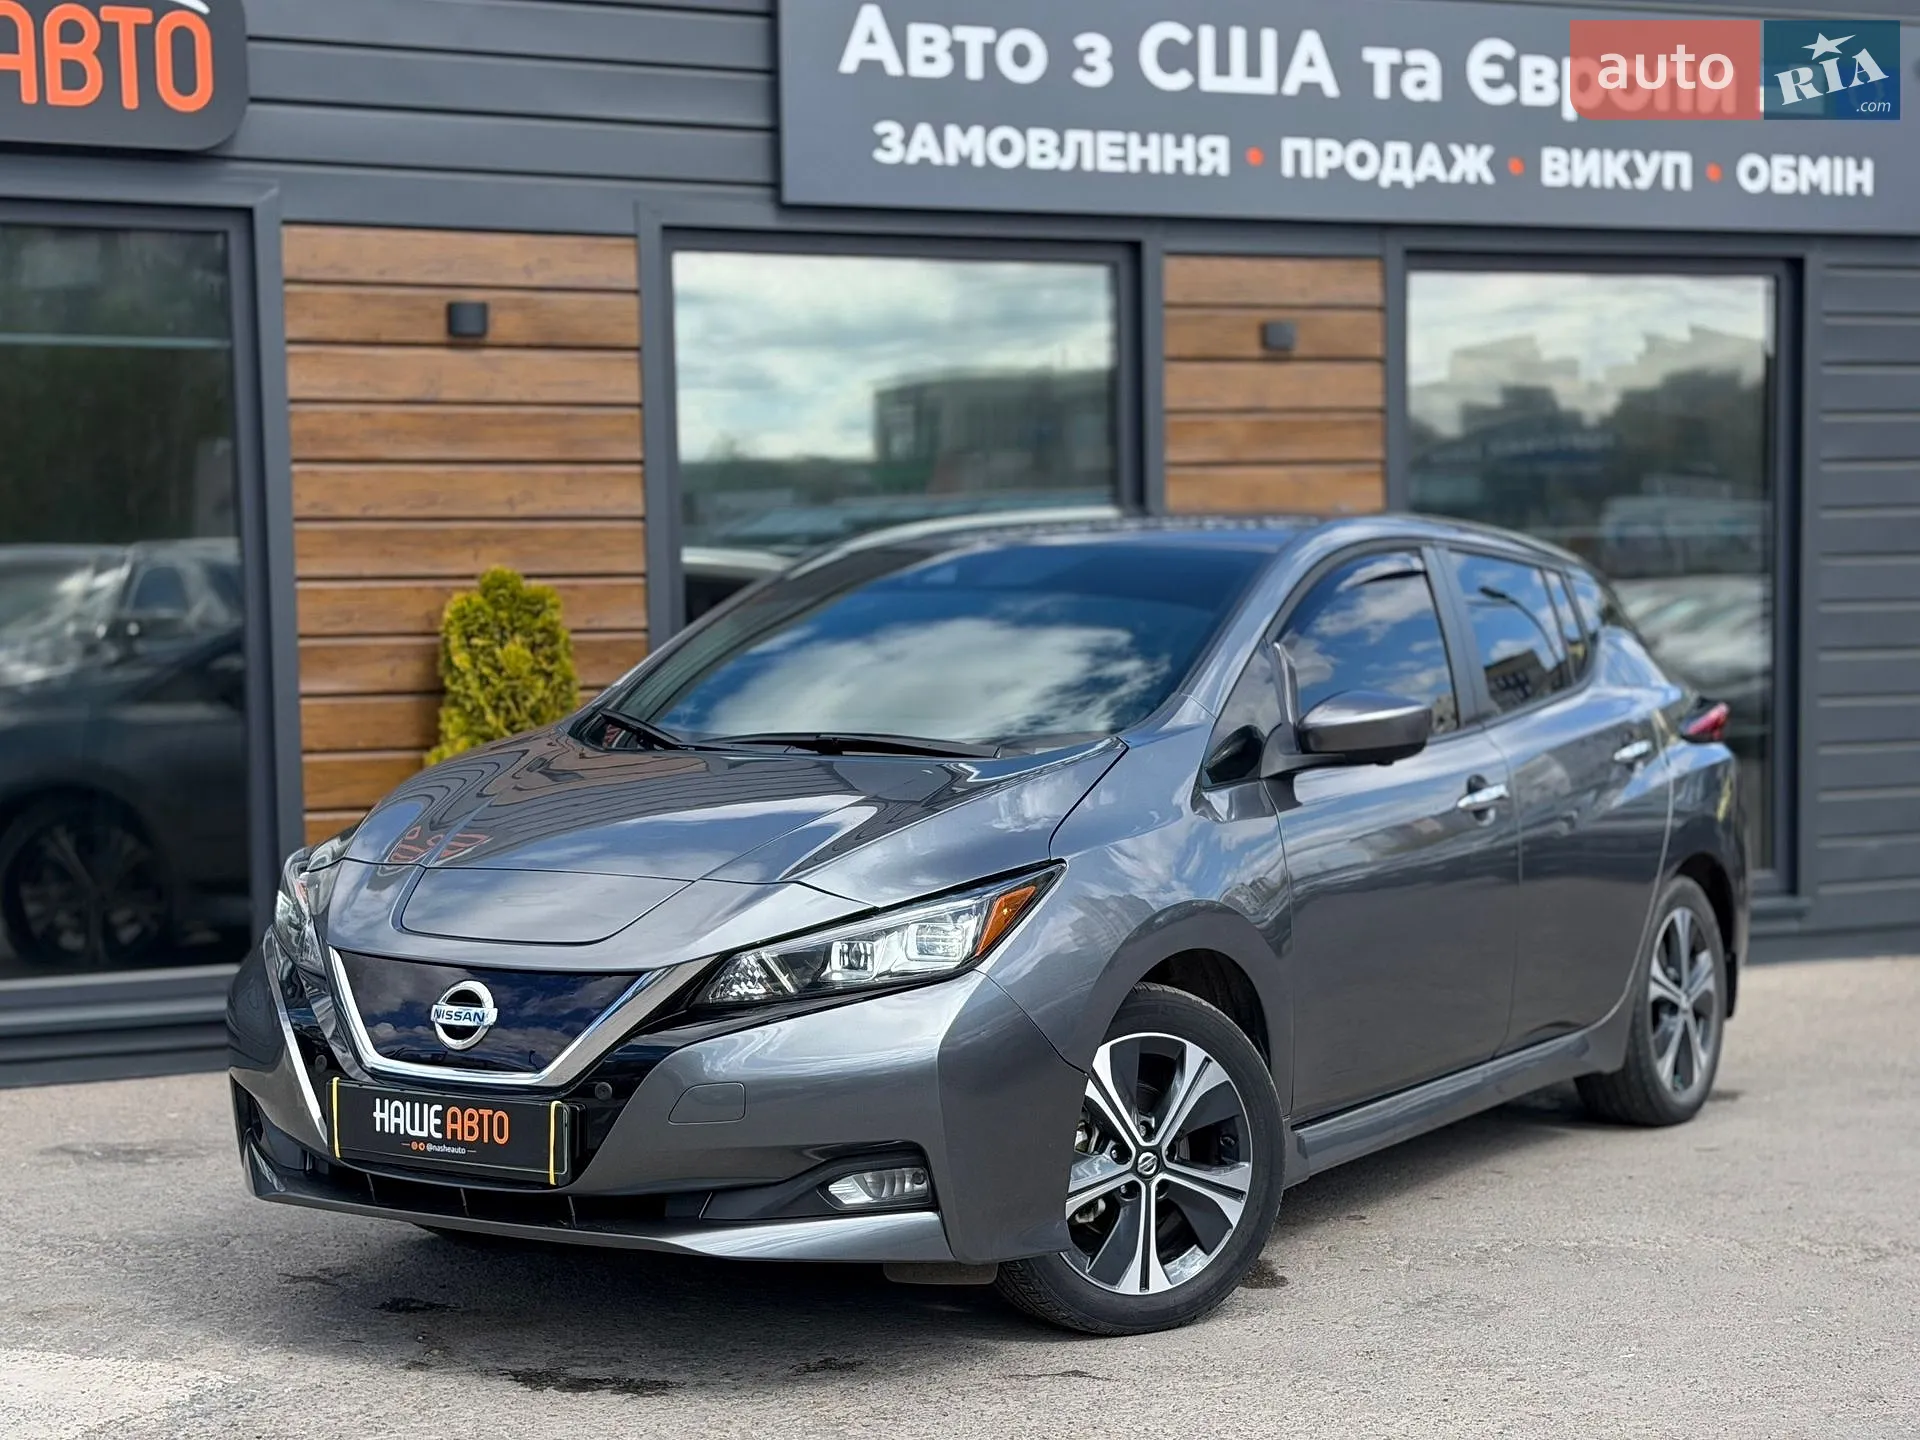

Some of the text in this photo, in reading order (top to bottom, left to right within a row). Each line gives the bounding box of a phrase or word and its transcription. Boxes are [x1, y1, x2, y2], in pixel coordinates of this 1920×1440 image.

[838, 3, 1049, 85] Авто
[1072, 32, 1114, 88] з
[1138, 20, 1340, 98] США
[1361, 46, 1443, 102] та
[872, 120, 1875, 197] ЗАМОВЛЕННЯ ПРОДАЖ ВИКУП ОБМІН
[433, 1008, 486, 1023] NISSAN
